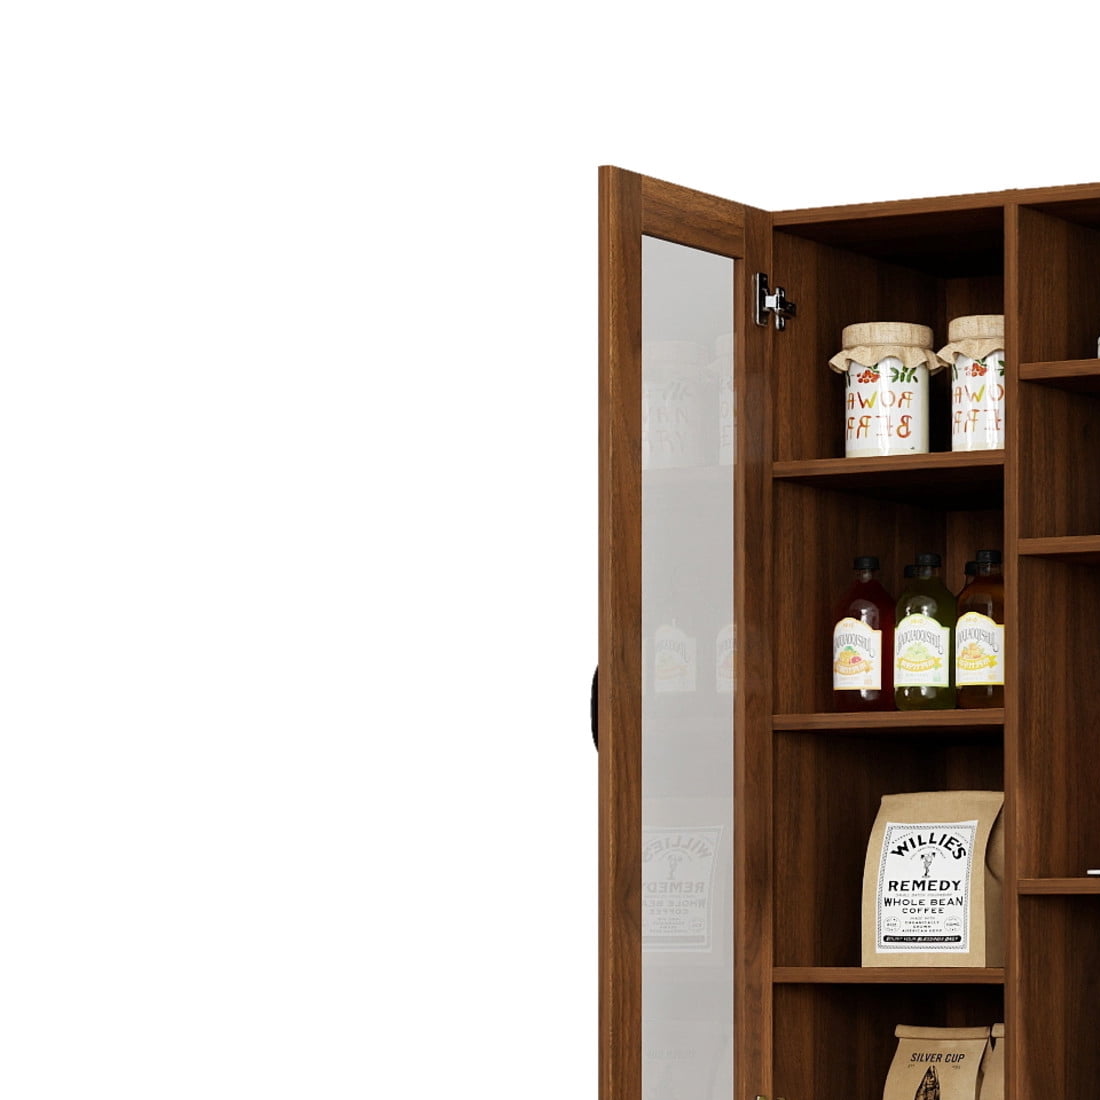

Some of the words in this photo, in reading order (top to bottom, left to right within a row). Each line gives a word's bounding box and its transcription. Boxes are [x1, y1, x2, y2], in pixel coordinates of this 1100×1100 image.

[890, 832, 967, 860] WILLIE'S
[888, 879, 962, 892] REMEDY
[884, 897, 925, 907] WHOLE
[930, 896, 964, 907] BEAN
[910, 1053, 943, 1063] SILVER
[944, 1053, 966, 1063] CUP
